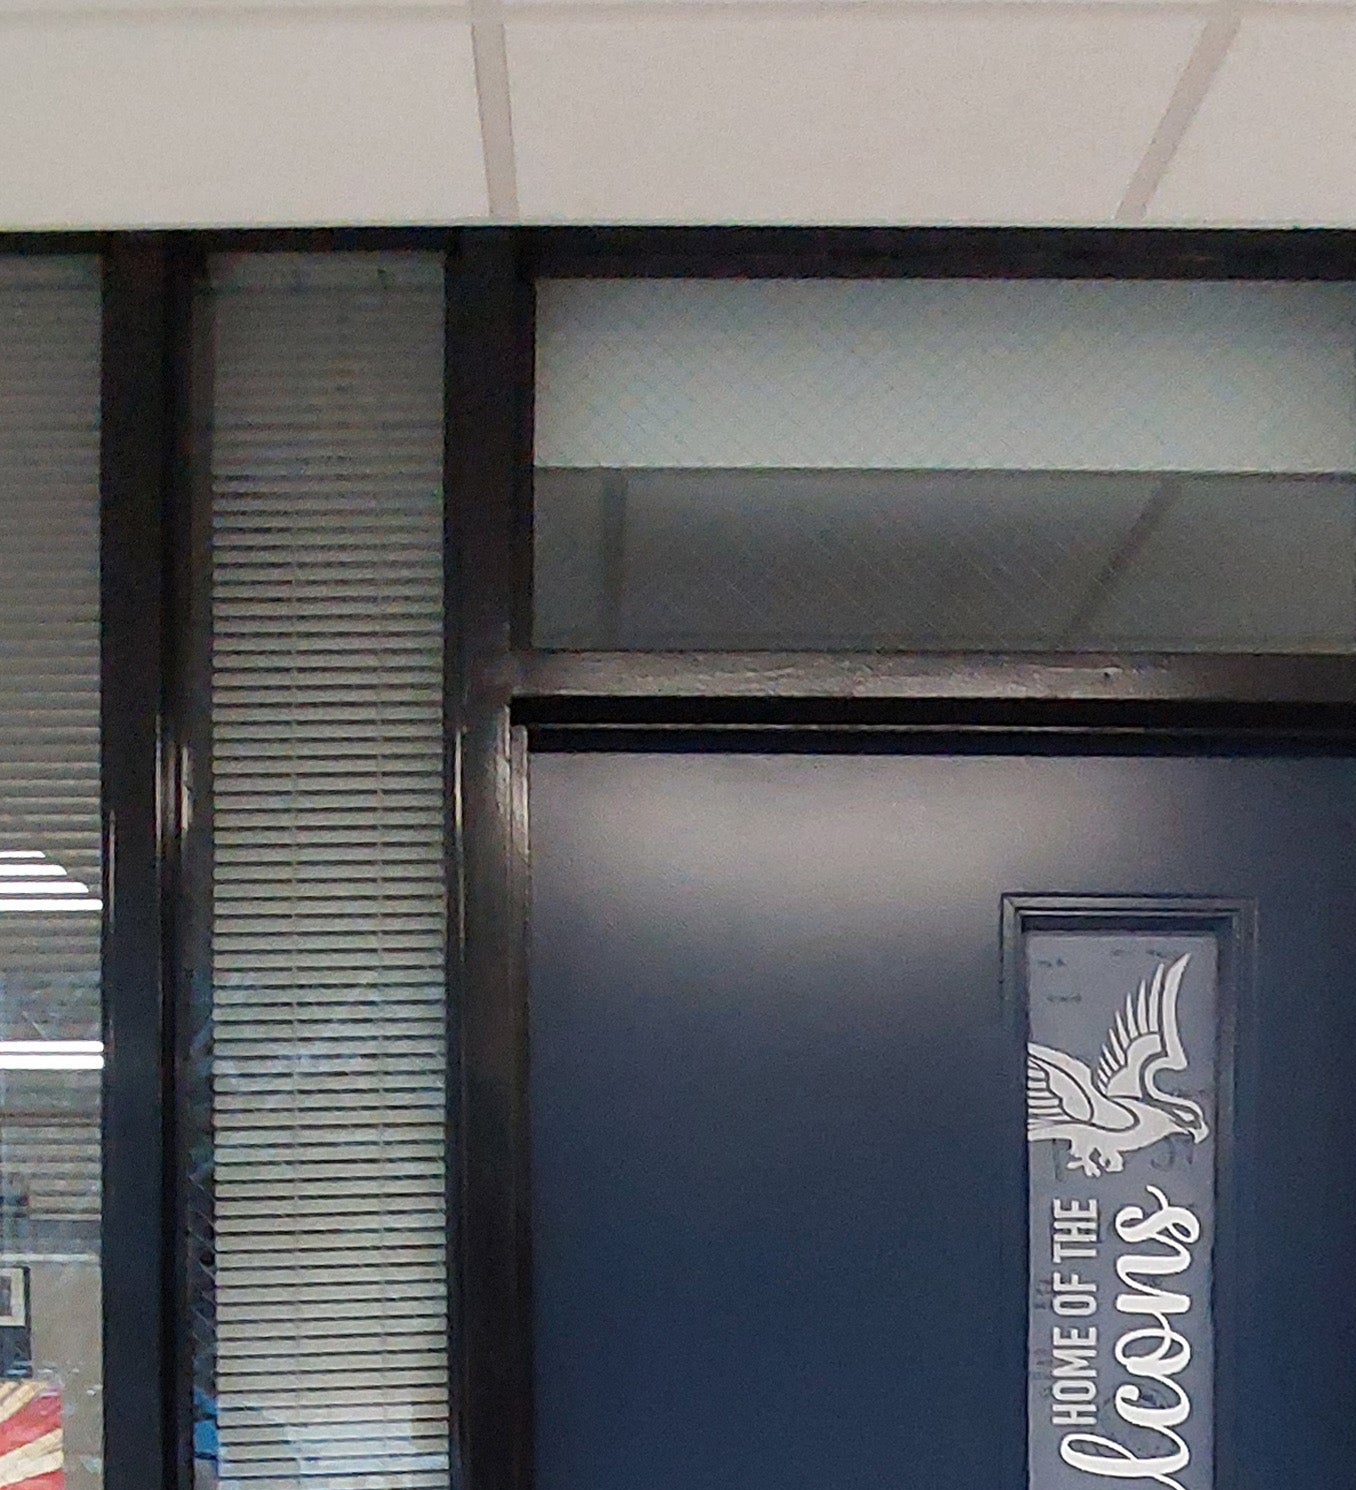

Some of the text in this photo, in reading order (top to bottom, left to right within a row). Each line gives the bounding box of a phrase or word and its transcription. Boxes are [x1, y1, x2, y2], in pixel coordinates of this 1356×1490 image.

[1052, 1197, 1098, 1427] HOME OF THE
